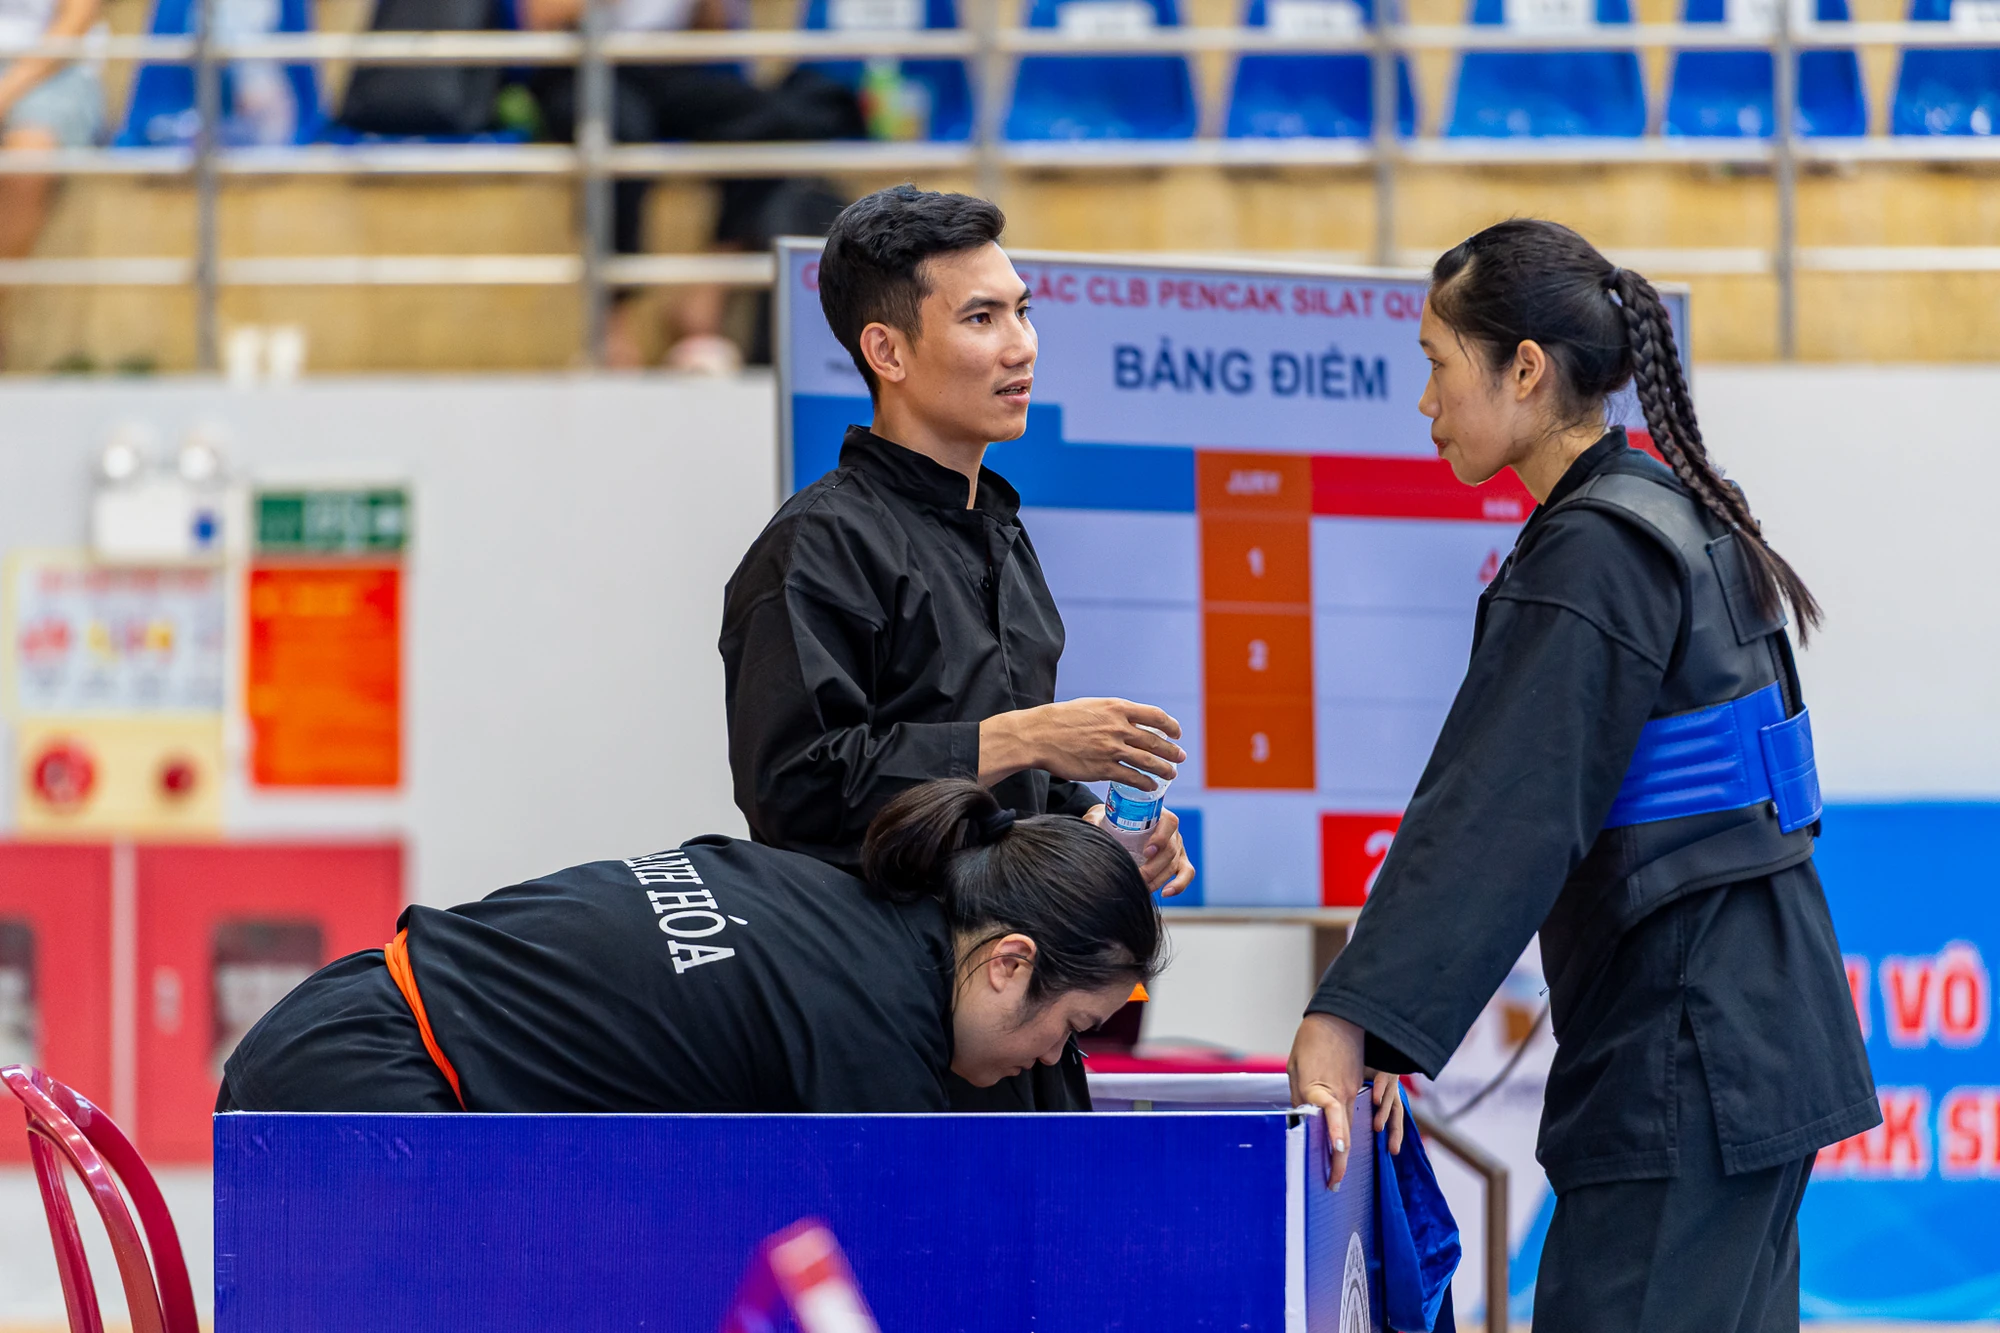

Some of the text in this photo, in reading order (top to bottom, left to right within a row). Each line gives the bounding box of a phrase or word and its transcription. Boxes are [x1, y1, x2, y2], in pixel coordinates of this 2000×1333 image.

[1018, 266, 1078, 304] ÁC
[1086, 275, 1149, 307] CLB
[1158, 280, 1283, 315] PENCAK
[1292, 285, 1374, 318] SILAT
[1114, 335, 1254, 394] BẢNG
[1247, 548, 1264, 577] 1
[1247, 639, 1269, 672] 2
[1250, 732, 1270, 763] 3
[646, 889, 748, 974] HÓA
[1882, 942, 1986, 1044] VÔ
